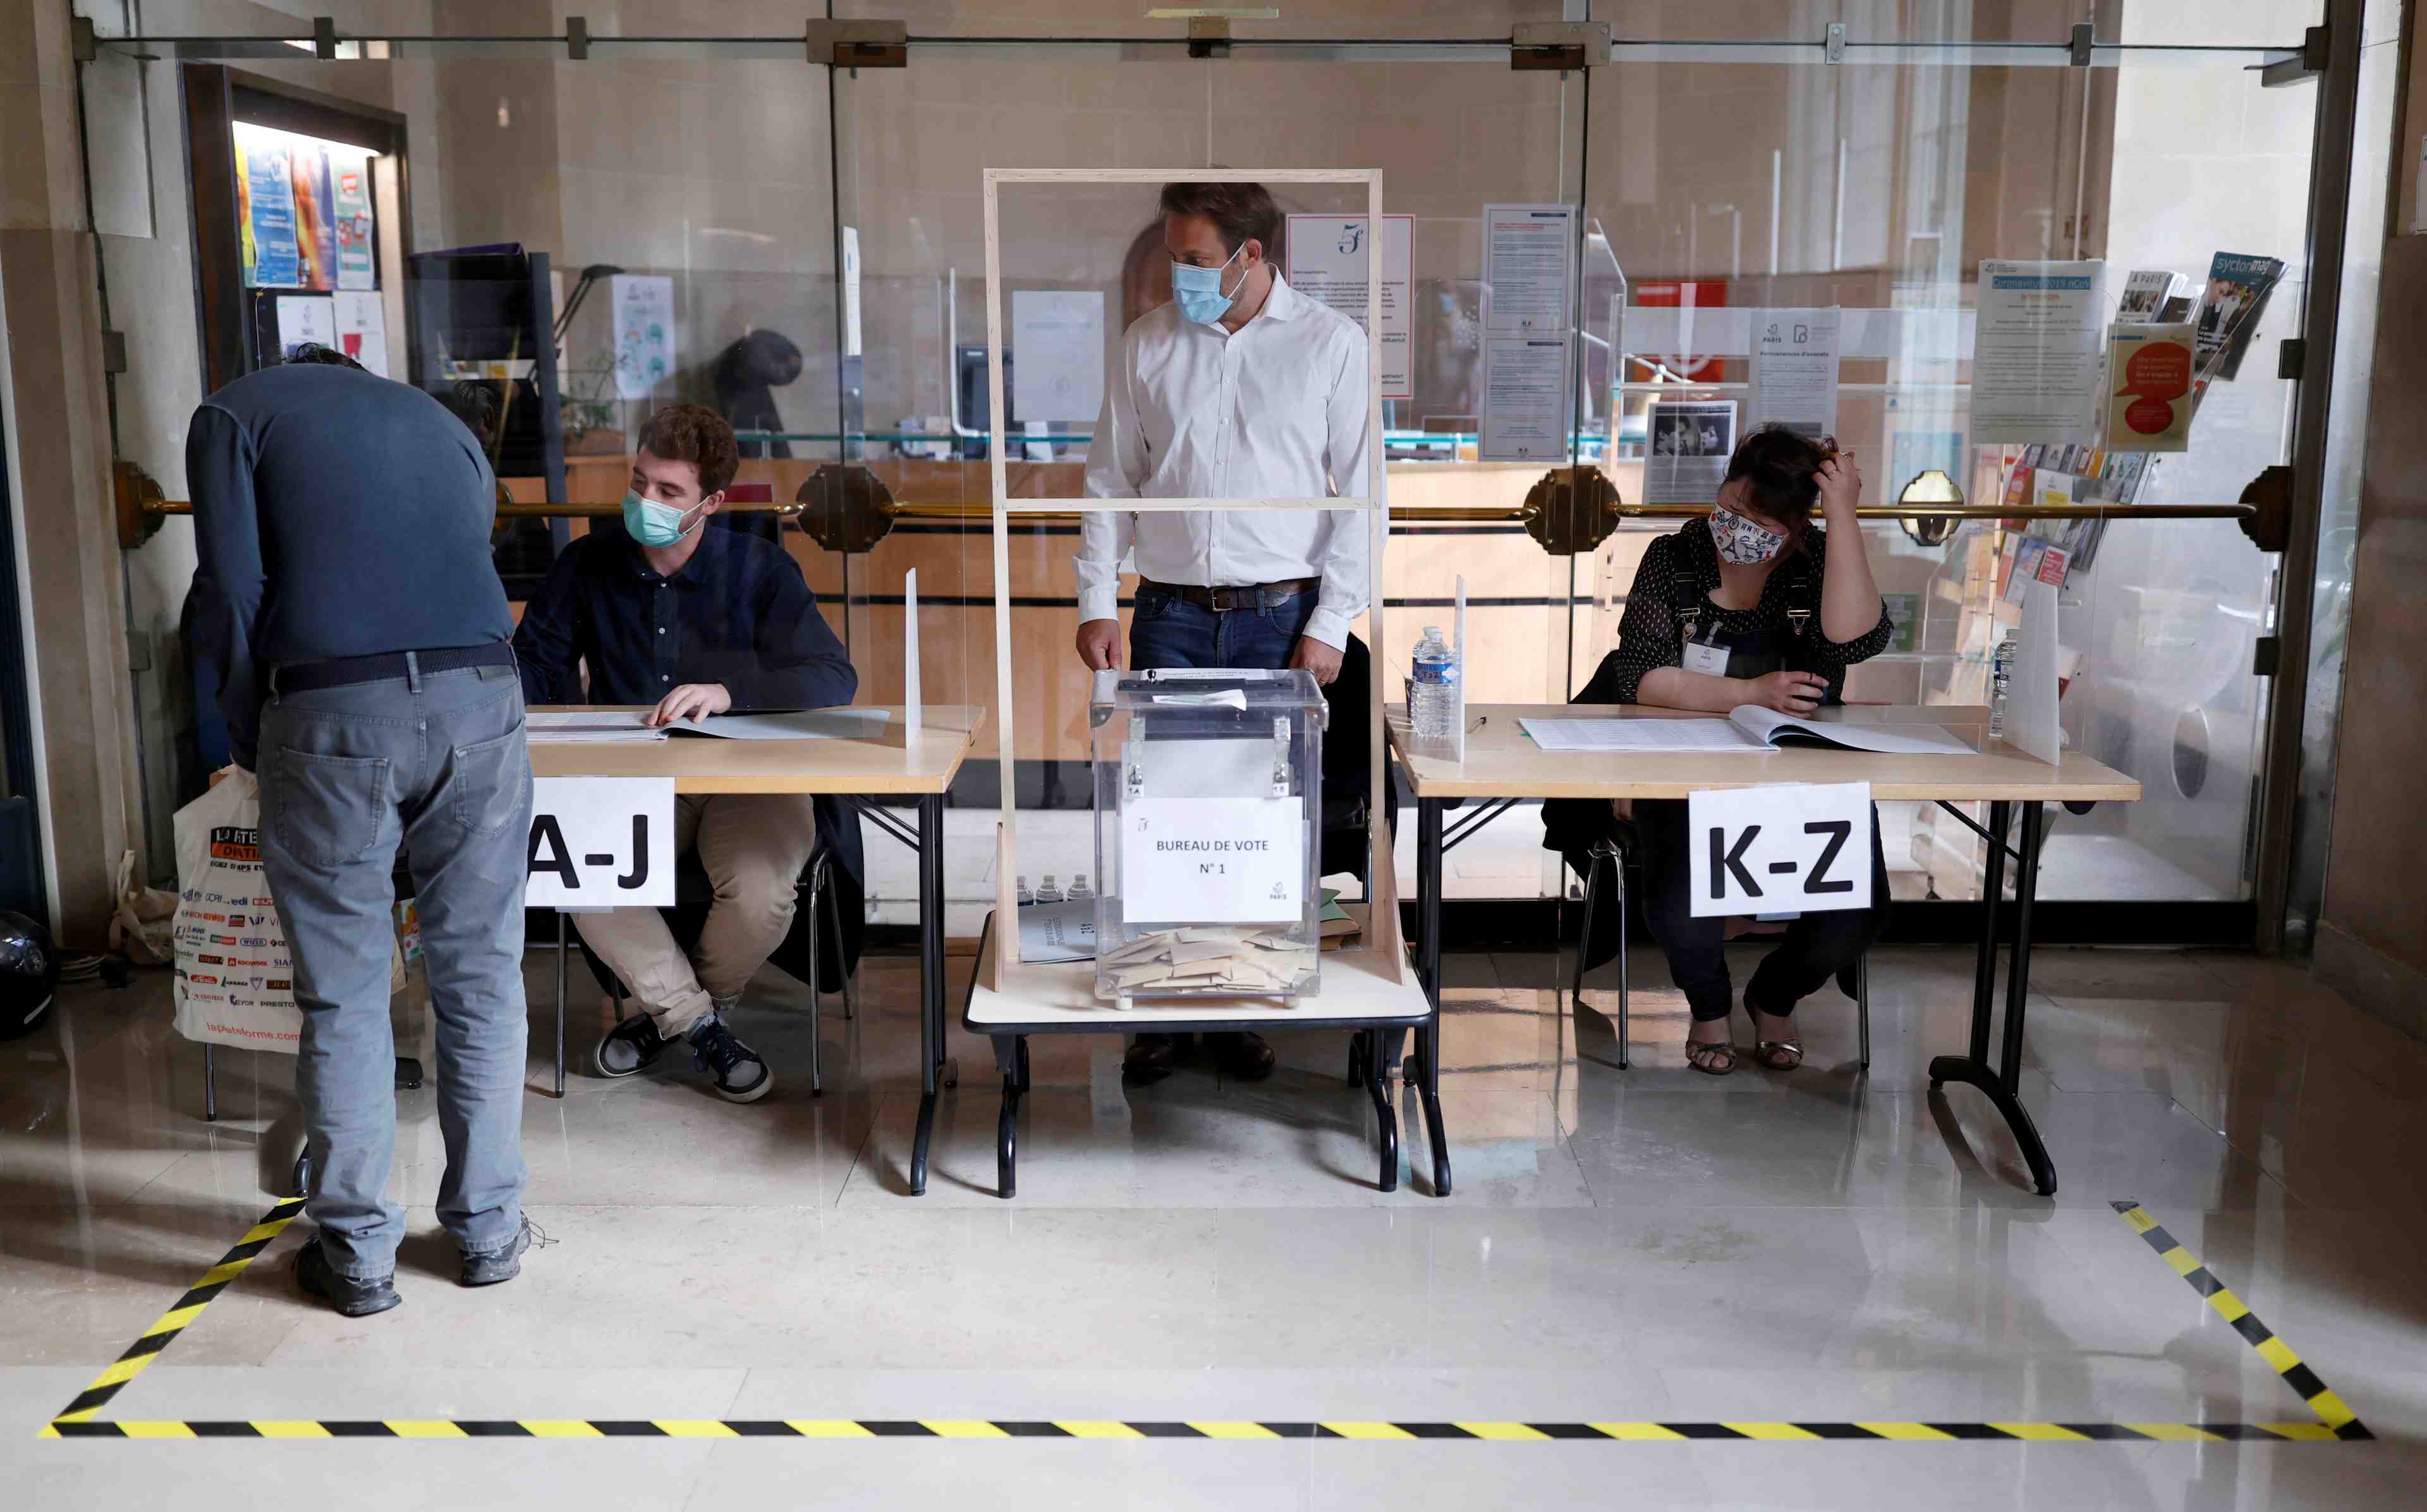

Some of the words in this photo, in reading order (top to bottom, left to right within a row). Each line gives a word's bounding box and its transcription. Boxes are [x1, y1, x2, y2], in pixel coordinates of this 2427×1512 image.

[527, 814, 648, 889] A-J
[1157, 840, 1210, 851] BUREAU
[1214, 840, 1231, 851] DE
[1234, 840, 1269, 851] VOTE
[1710, 820, 1853, 899] K-Z
[1200, 863, 1214, 874] N°
[1219, 864, 1225, 874] 1
